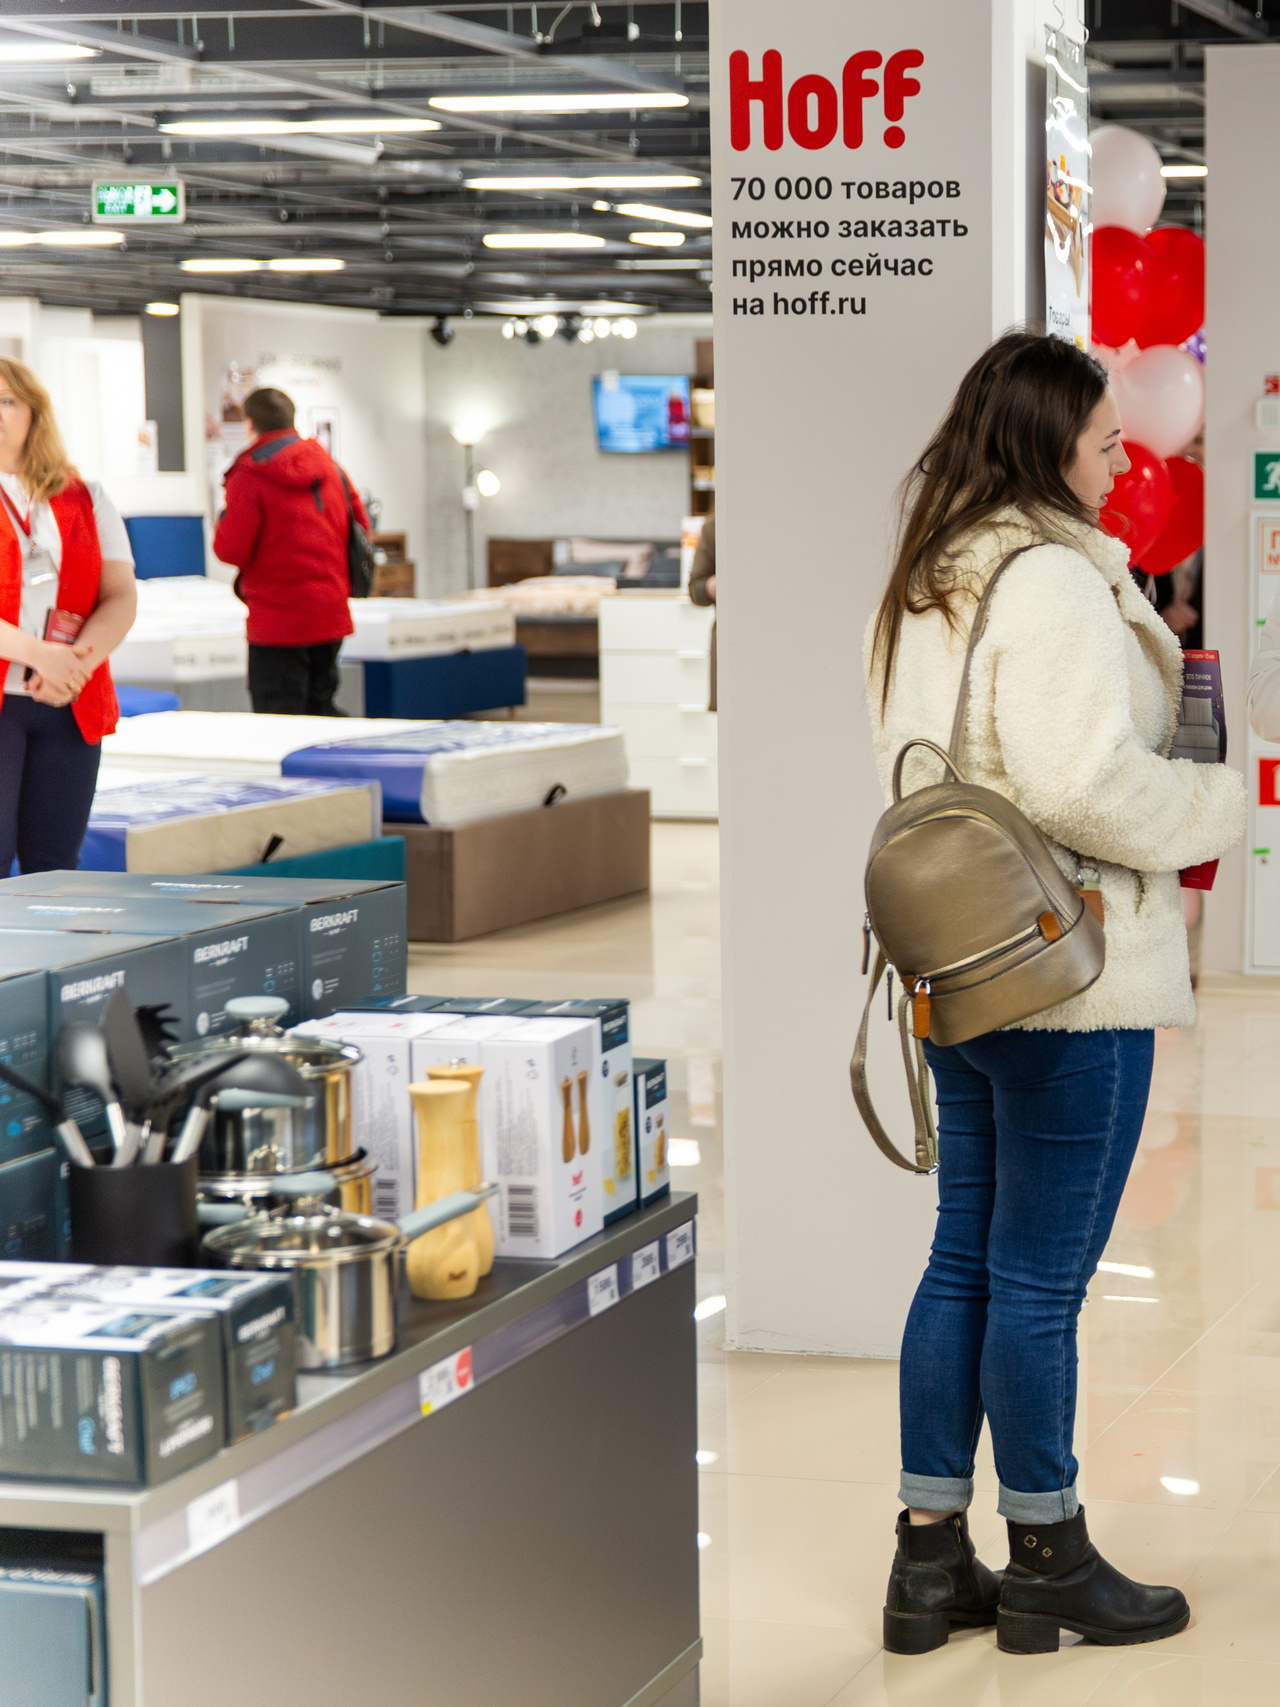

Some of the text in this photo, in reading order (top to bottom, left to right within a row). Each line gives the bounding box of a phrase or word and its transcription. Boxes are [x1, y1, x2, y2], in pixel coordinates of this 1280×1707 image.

[729, 48, 924, 151] Hoff
[730, 176, 961, 205] 70 000 товаров
[731, 219, 969, 239] можно заказать
[732, 252, 934, 283] прямо сейчас
[732, 290, 867, 316] на hoff.ru
[1049, 305, 1071, 330] Товары
[309, 908, 360, 933] BERKRAFT
[193, 935, 250, 964] BERKRAFT
[60, 970, 127, 1003] BERKRAFT
[102, 1355, 125, 1456] BERKRAFT
